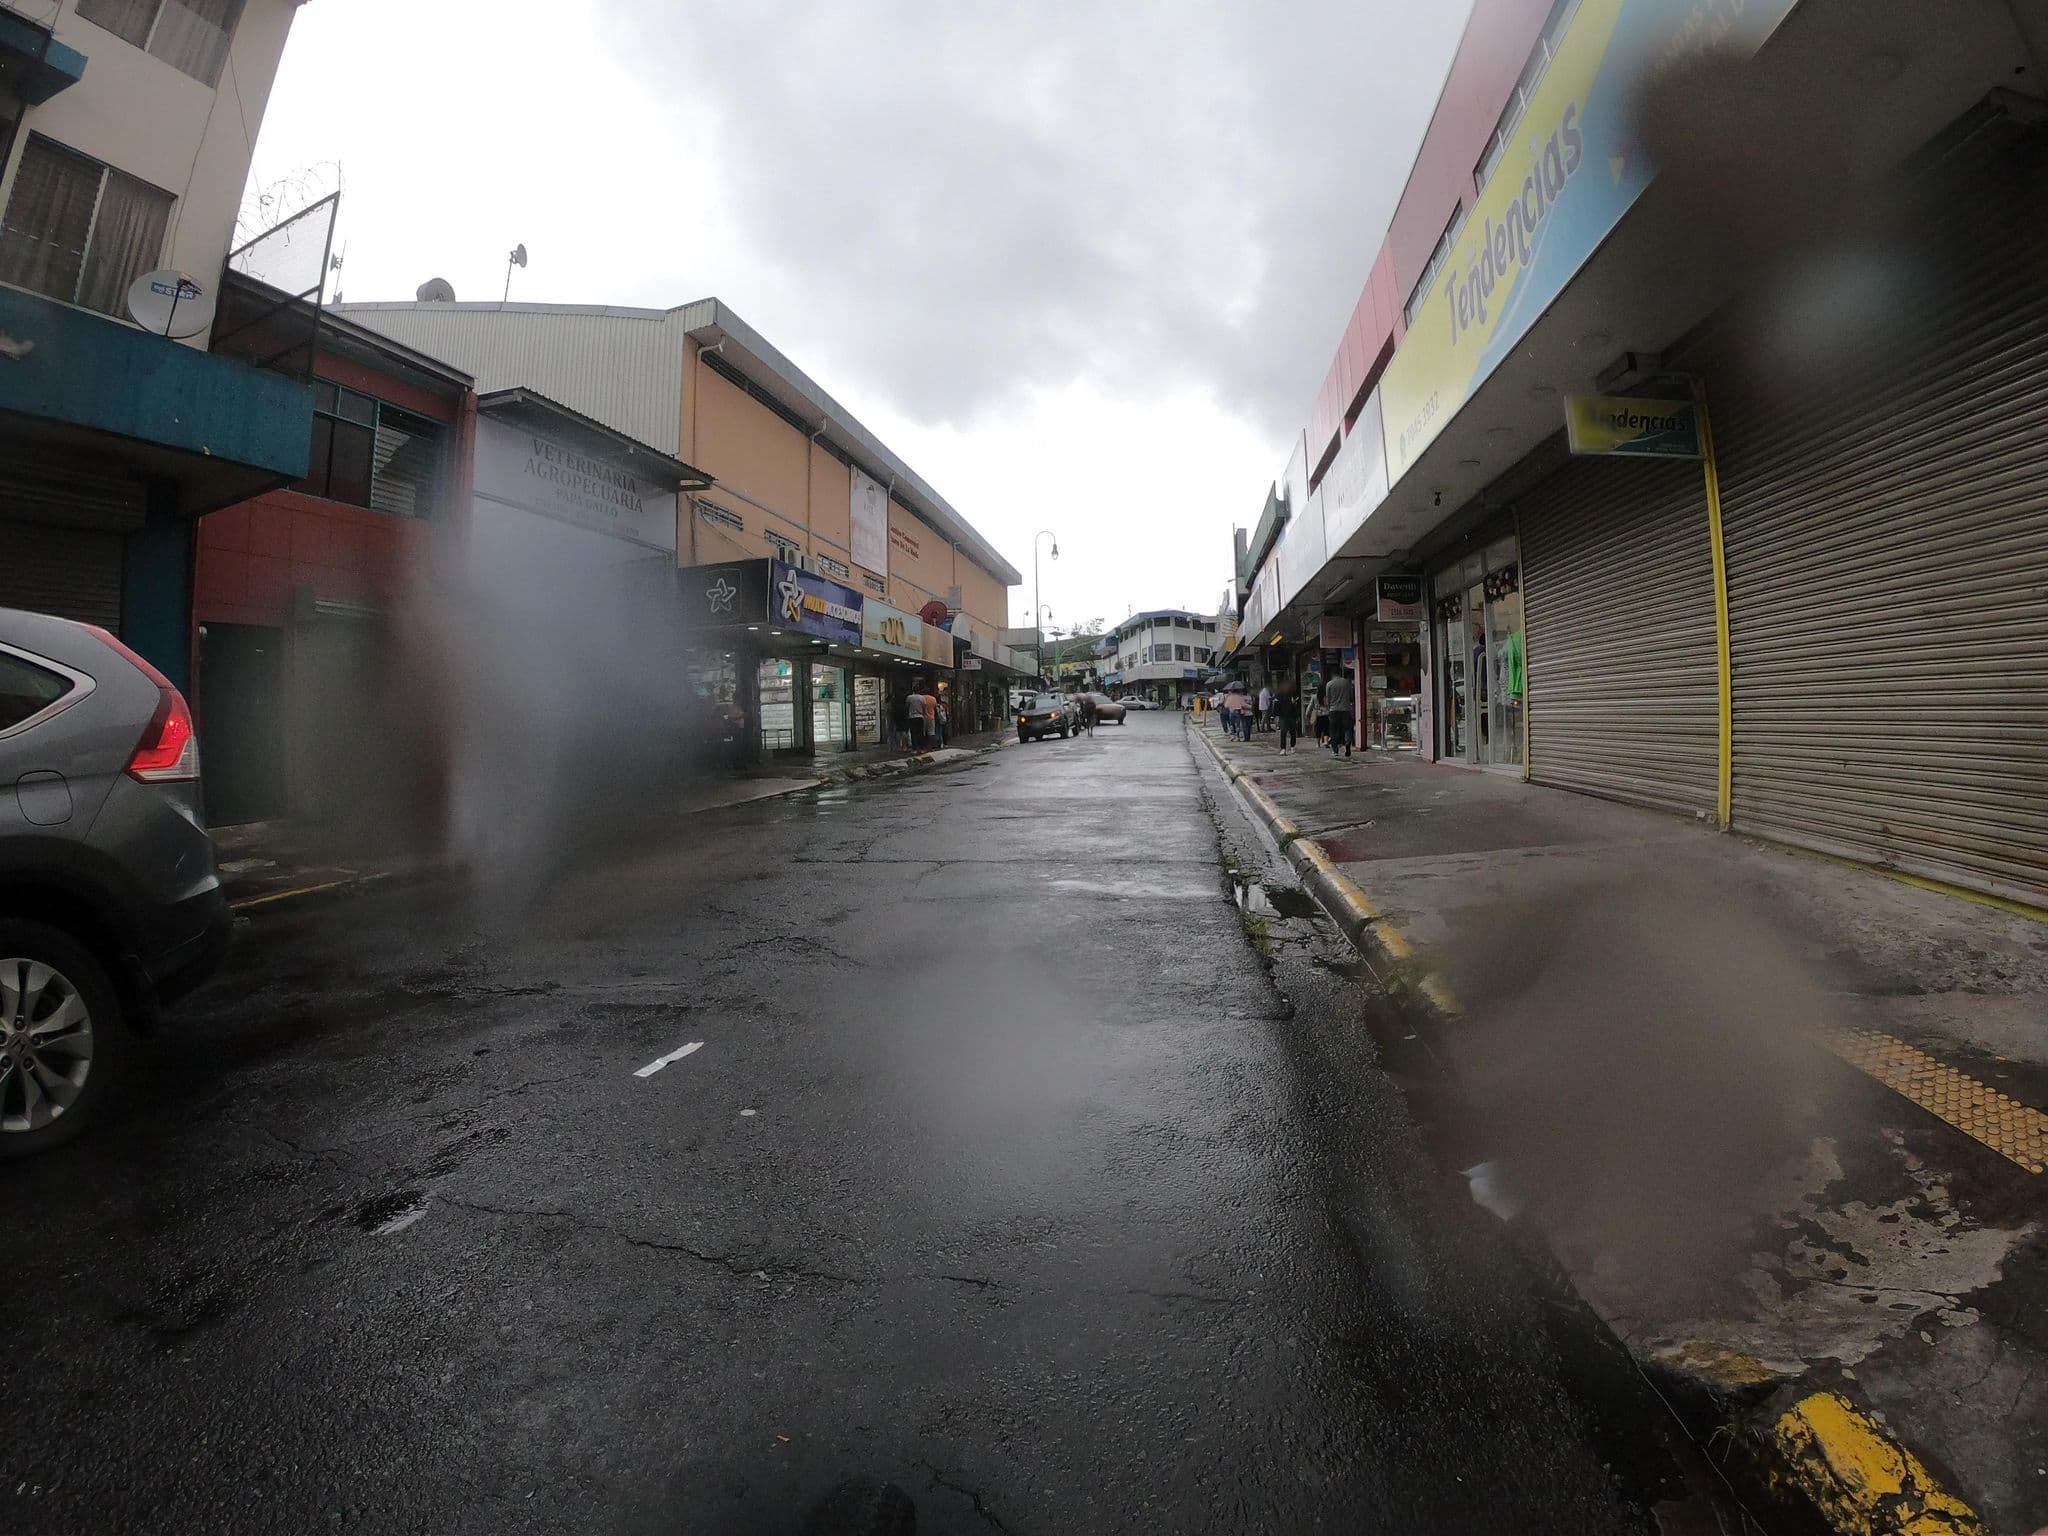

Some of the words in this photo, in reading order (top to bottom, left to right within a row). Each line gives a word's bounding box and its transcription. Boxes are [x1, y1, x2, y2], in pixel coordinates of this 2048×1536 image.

[1444, 100, 1584, 346] Tendencias
[524, 457, 643, 513] AGROPECUARIA
[533, 438, 637, 493] VETERINARIA
